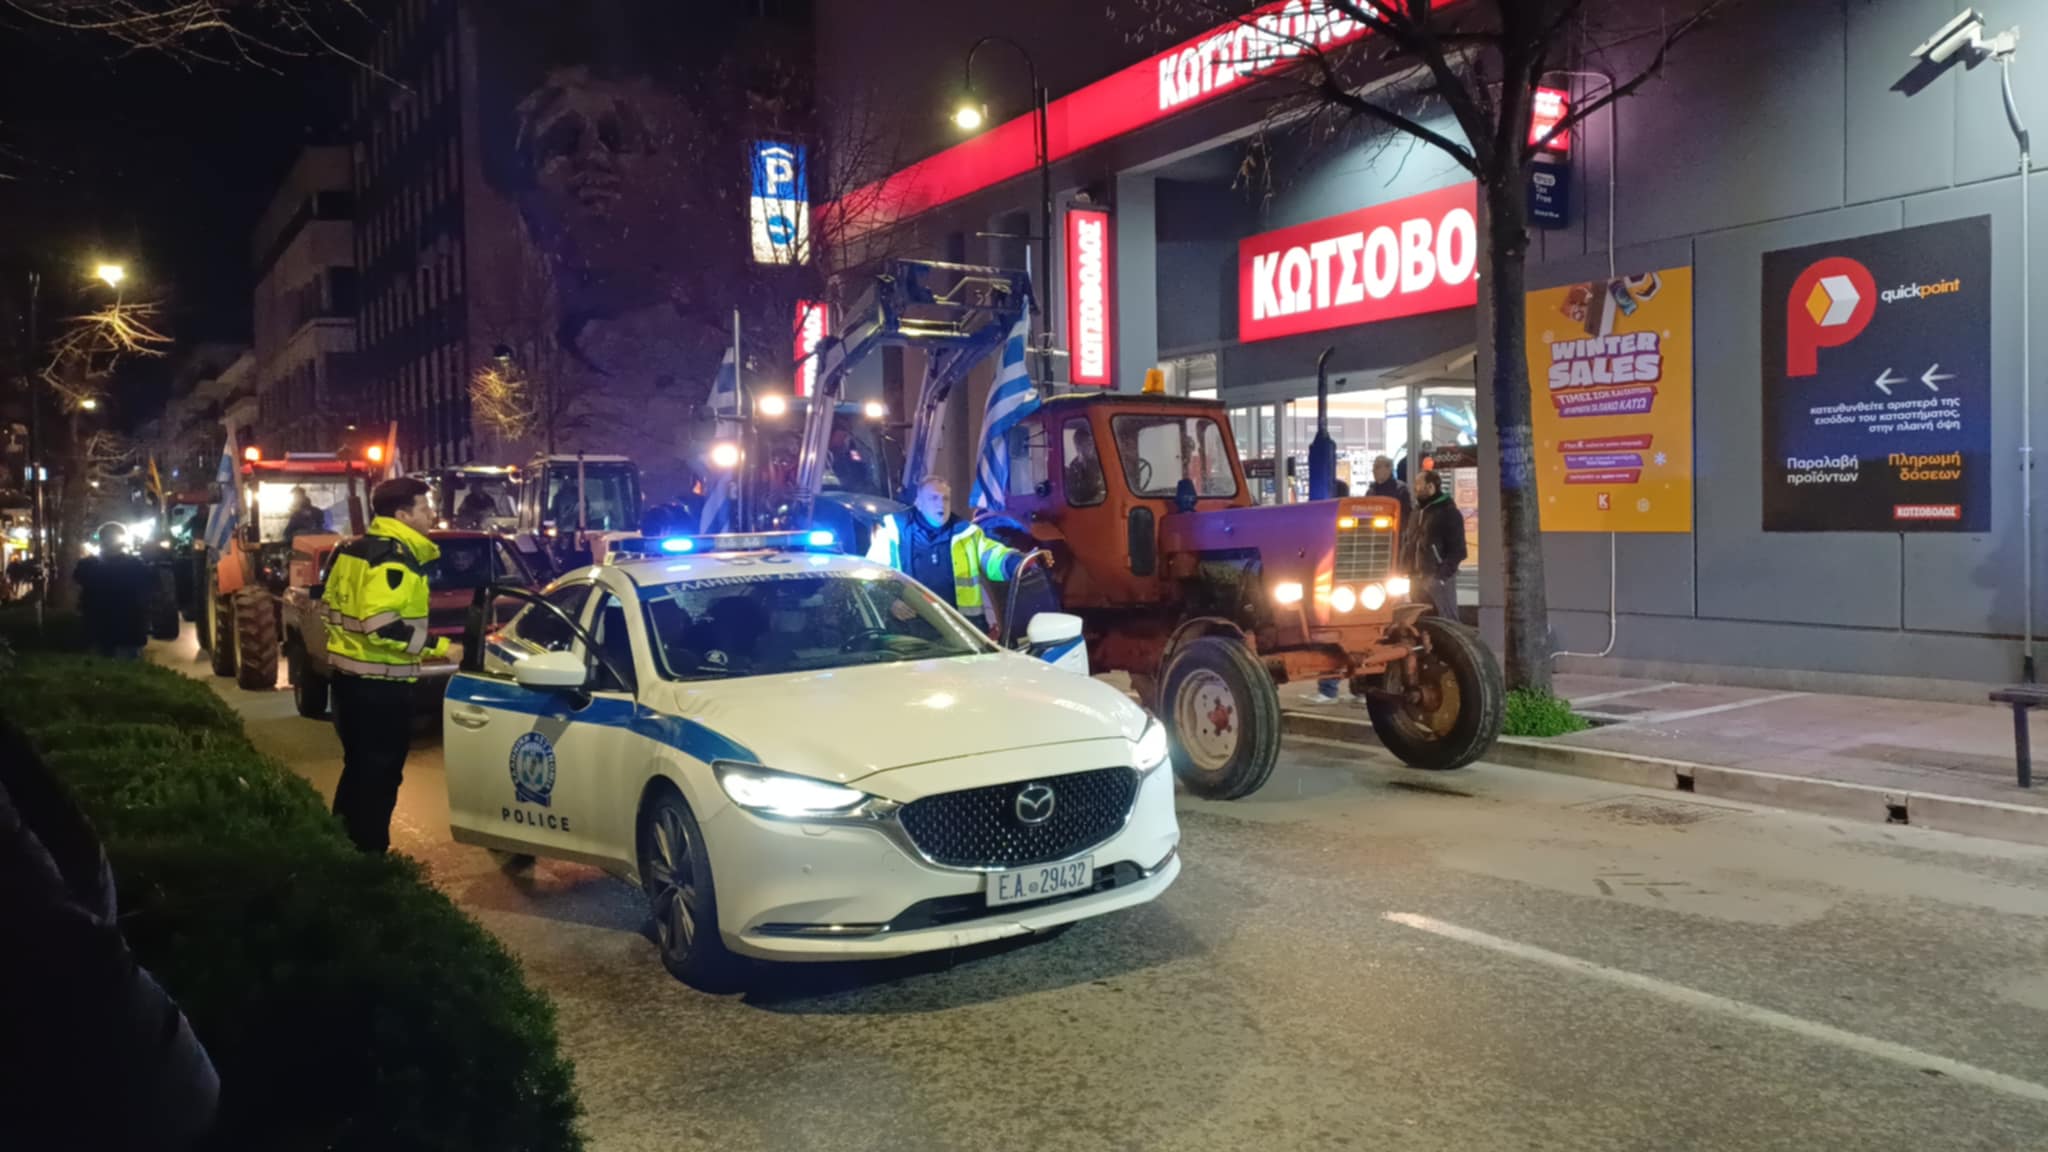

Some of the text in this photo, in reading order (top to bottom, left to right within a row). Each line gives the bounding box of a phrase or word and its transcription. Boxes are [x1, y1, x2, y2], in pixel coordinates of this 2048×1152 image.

[766, 157, 793, 194] P
[1253, 208, 1480, 320] ΚΩΤΣΟΒΟ
[1881, 278, 1960, 303] quickpoint
[1552, 332, 1658, 360] WINTER
[1549, 354, 1660, 389] SALES
[1810, 397, 1960, 414] κατευθυνθείτε αριστερά της
[1815, 413, 1855, 425] εισόδου
[1859, 415, 1876, 423] του
[1869, 424, 1893, 434] στην
[1937, 420, 1960, 431] όψη
[1787, 455, 1858, 471] Παραλαβή
[1888, 451, 1960, 467] Πληρωμή
[1787, 471, 1858, 486] προϊόντων
[1900, 467, 1960, 481] δόσεων
[502, 807, 570, 832] POLICE
[1040, 862, 1086, 893] 29432
